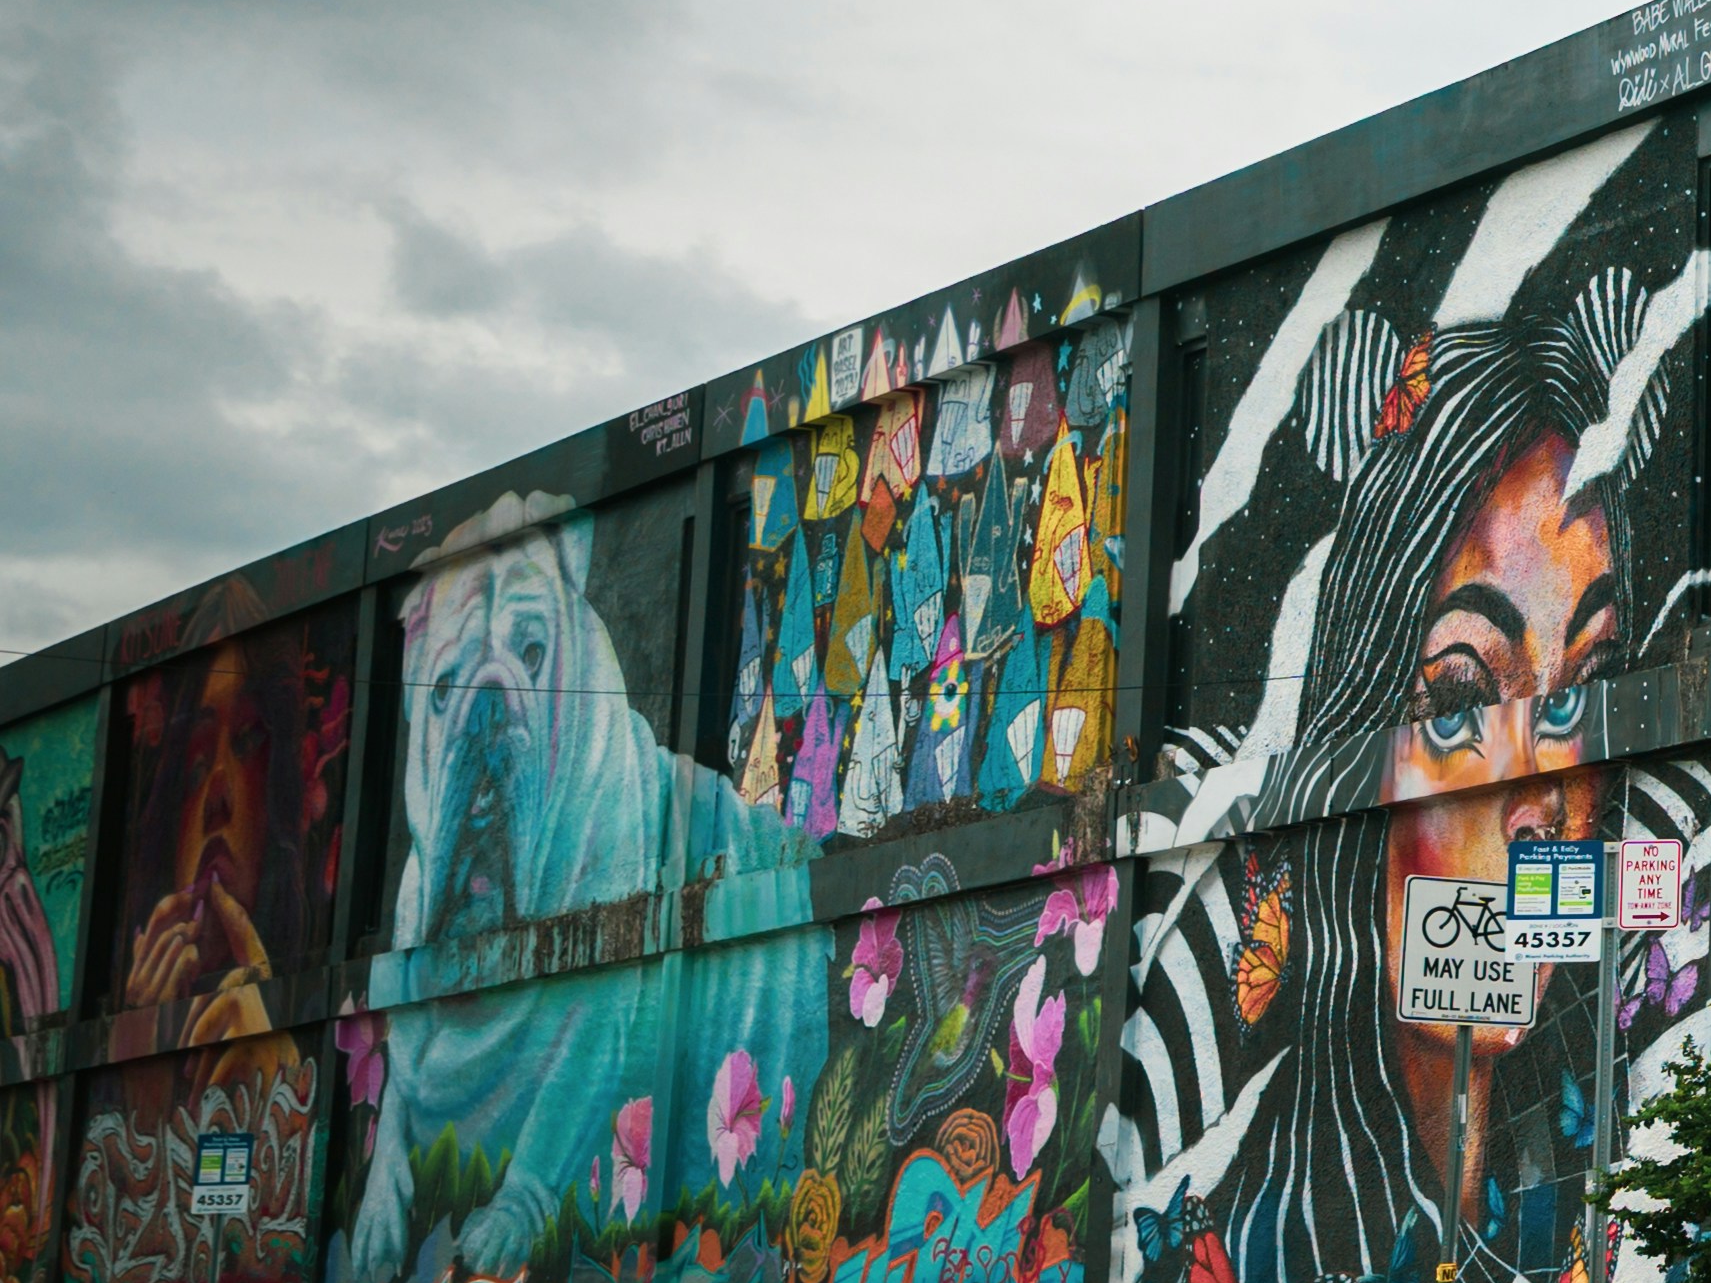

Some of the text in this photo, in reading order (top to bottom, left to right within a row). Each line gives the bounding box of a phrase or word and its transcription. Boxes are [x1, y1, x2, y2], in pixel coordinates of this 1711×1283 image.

[836, 333, 855, 359] ART
[1519, 853, 1594, 862] Parking Payments
[1643, 846, 1659, 857] NO
[1626, 860, 1676, 872] PARKING
[1639, 874, 1661, 885] ANY
[1637, 888, 1663, 899] TIME
[1514, 931, 1592, 949] 45357
[1423, 956, 1515, 983] MAY USE
[1411, 988, 1523, 1014] FULL LANE
[196, 1194, 244, 1206] 45357
